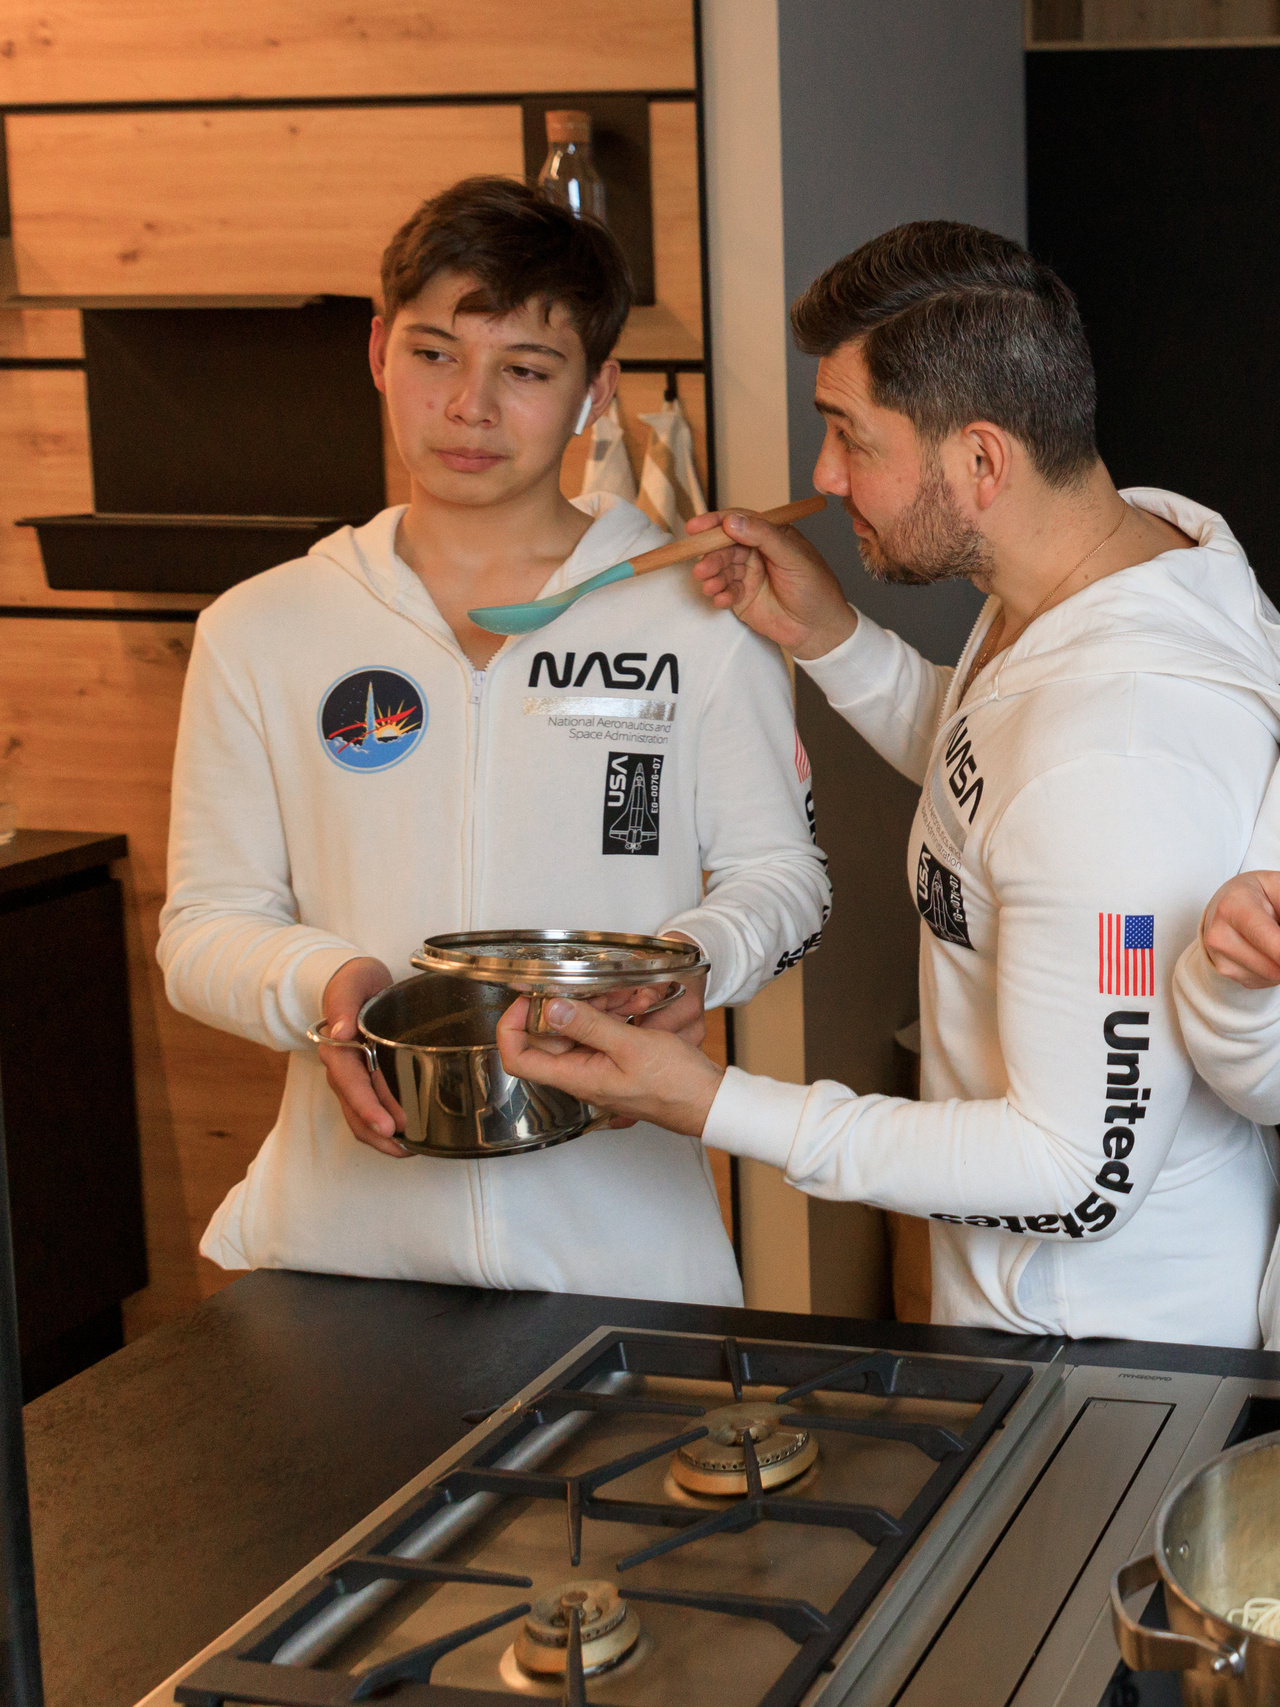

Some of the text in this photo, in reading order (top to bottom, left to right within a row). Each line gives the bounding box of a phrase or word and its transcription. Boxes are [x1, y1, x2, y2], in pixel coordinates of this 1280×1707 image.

[528, 651, 679, 694] NASA
[548, 717, 671, 733] National Aeronautics and
[569, 729, 668, 744] Space Administration
[608, 755, 629, 807] USA
[918, 851, 931, 900] USA
[930, 1010, 1152, 1238] United States
